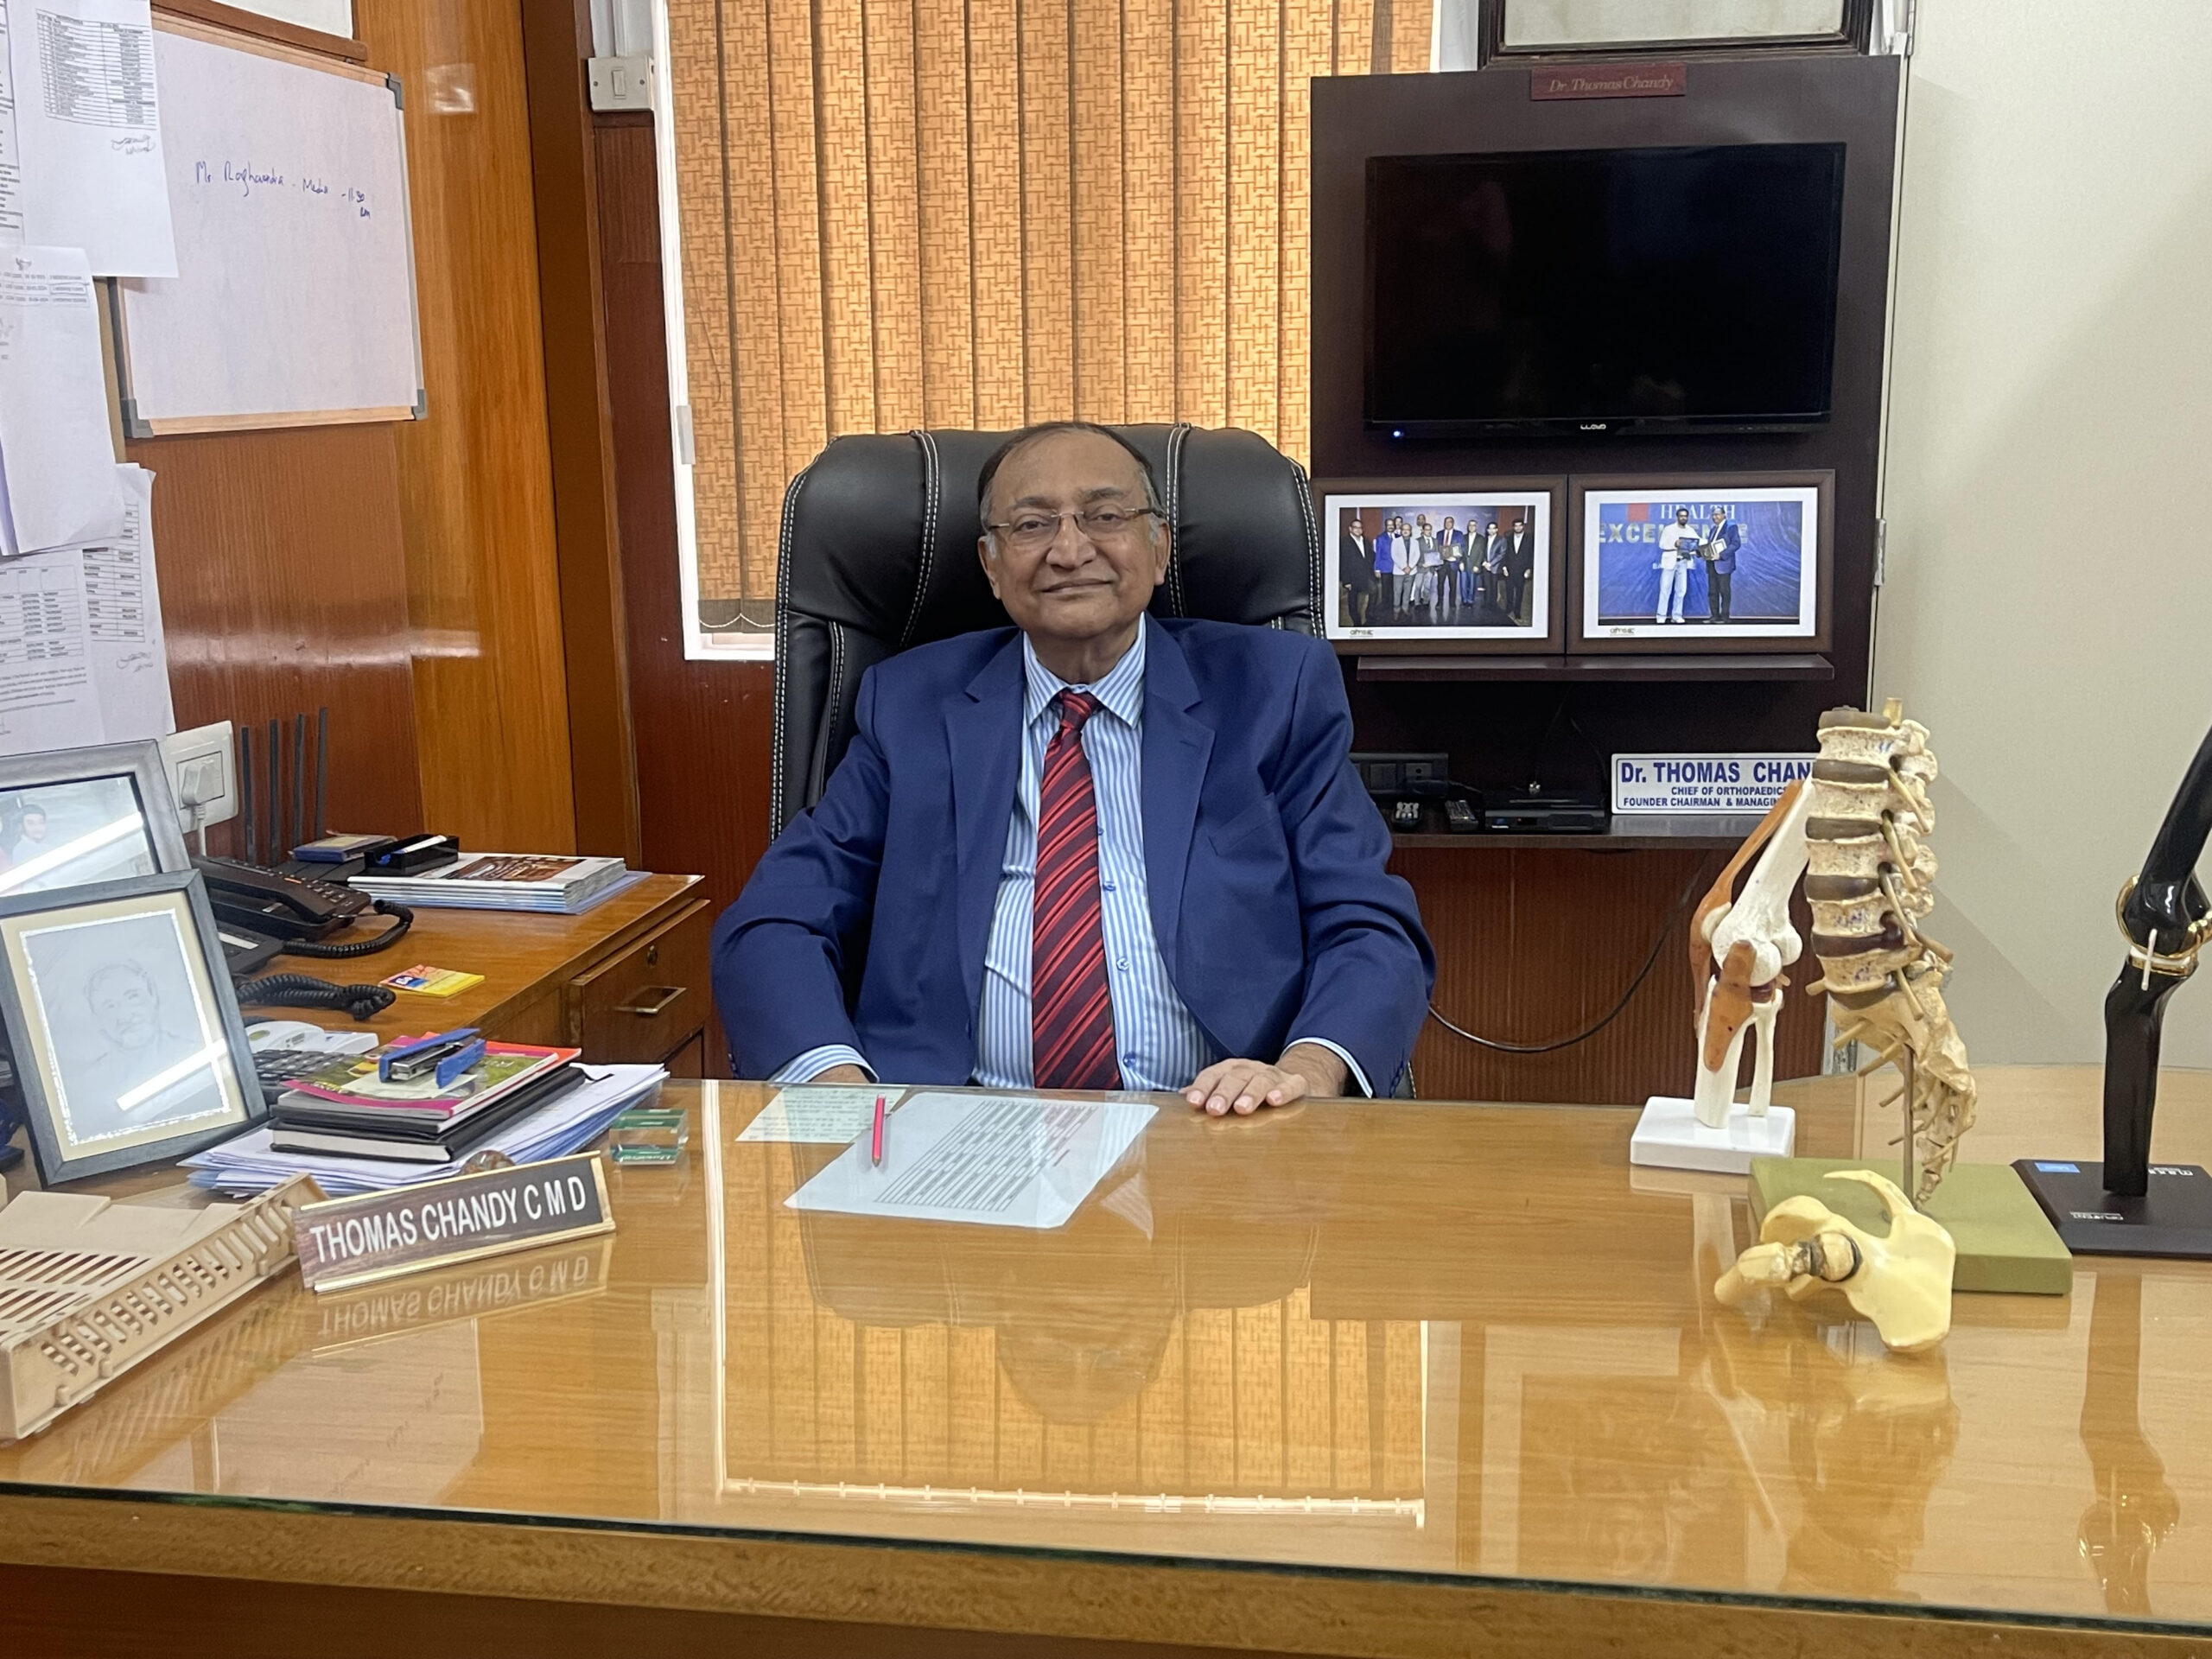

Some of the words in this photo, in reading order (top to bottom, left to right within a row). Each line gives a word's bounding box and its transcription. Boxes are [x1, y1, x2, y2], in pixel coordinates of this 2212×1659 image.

[1571, 77, 1622, 91] Thomas
[1623, 74, 1674, 90] Chandy
[1621, 762, 1647, 783] Dr.
[1653, 761, 1740, 783] THOMAS
[1671, 786, 1699, 795] CHIEF
[1701, 786, 1713, 795] OF
[1624, 798, 1668, 806] FOUNDER
[1670, 798, 1720, 806] CHAIRMAN
[1726, 798, 1733, 806] &
[309, 1208, 418, 1263] THOMAS
[421, 1187, 518, 1242] CHANDY
[524, 1184, 543, 1220] C
[544, 1179, 567, 1216] M
[568, 1175, 587, 1211] D
